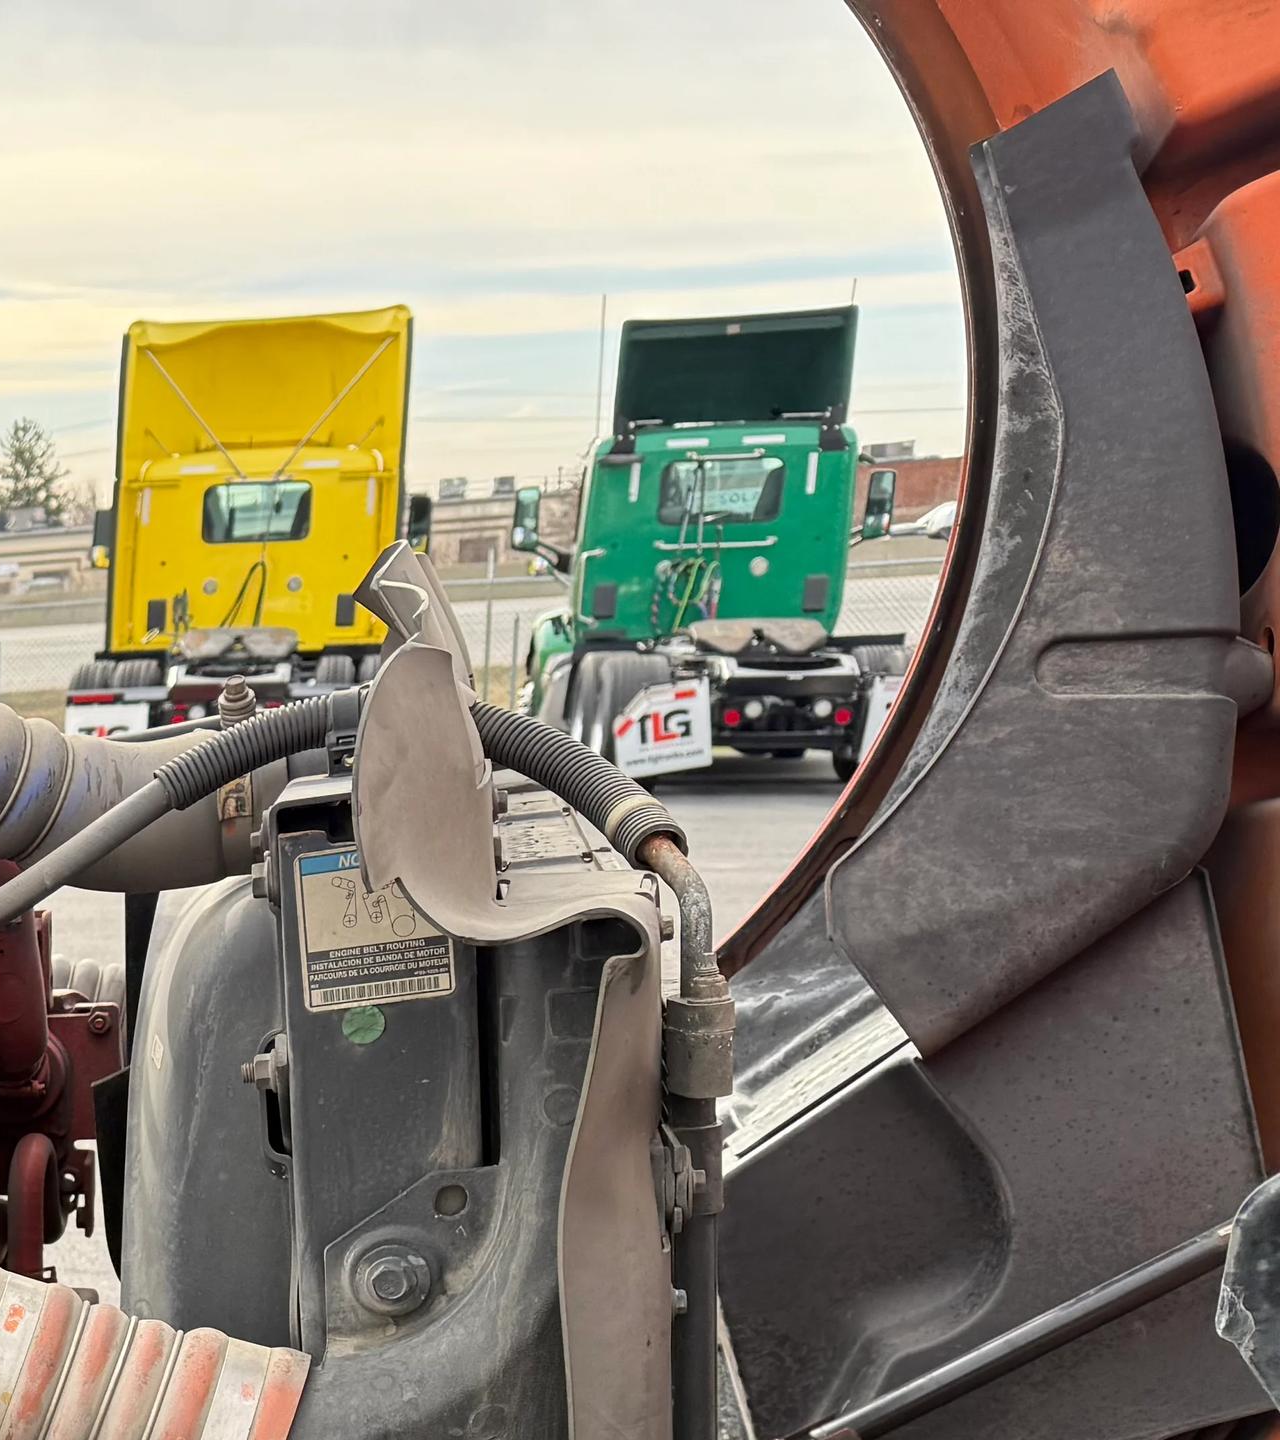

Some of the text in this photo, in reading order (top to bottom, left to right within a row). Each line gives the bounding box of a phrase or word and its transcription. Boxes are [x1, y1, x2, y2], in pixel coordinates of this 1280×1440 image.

[638, 709, 691, 744] TLG
[311, 947, 445, 971] INSTALACION DE BANDA DE MOTOR
[330, 939, 425, 958] ENGINE BELT ROUTING
[360, 967, 369, 976] LA
